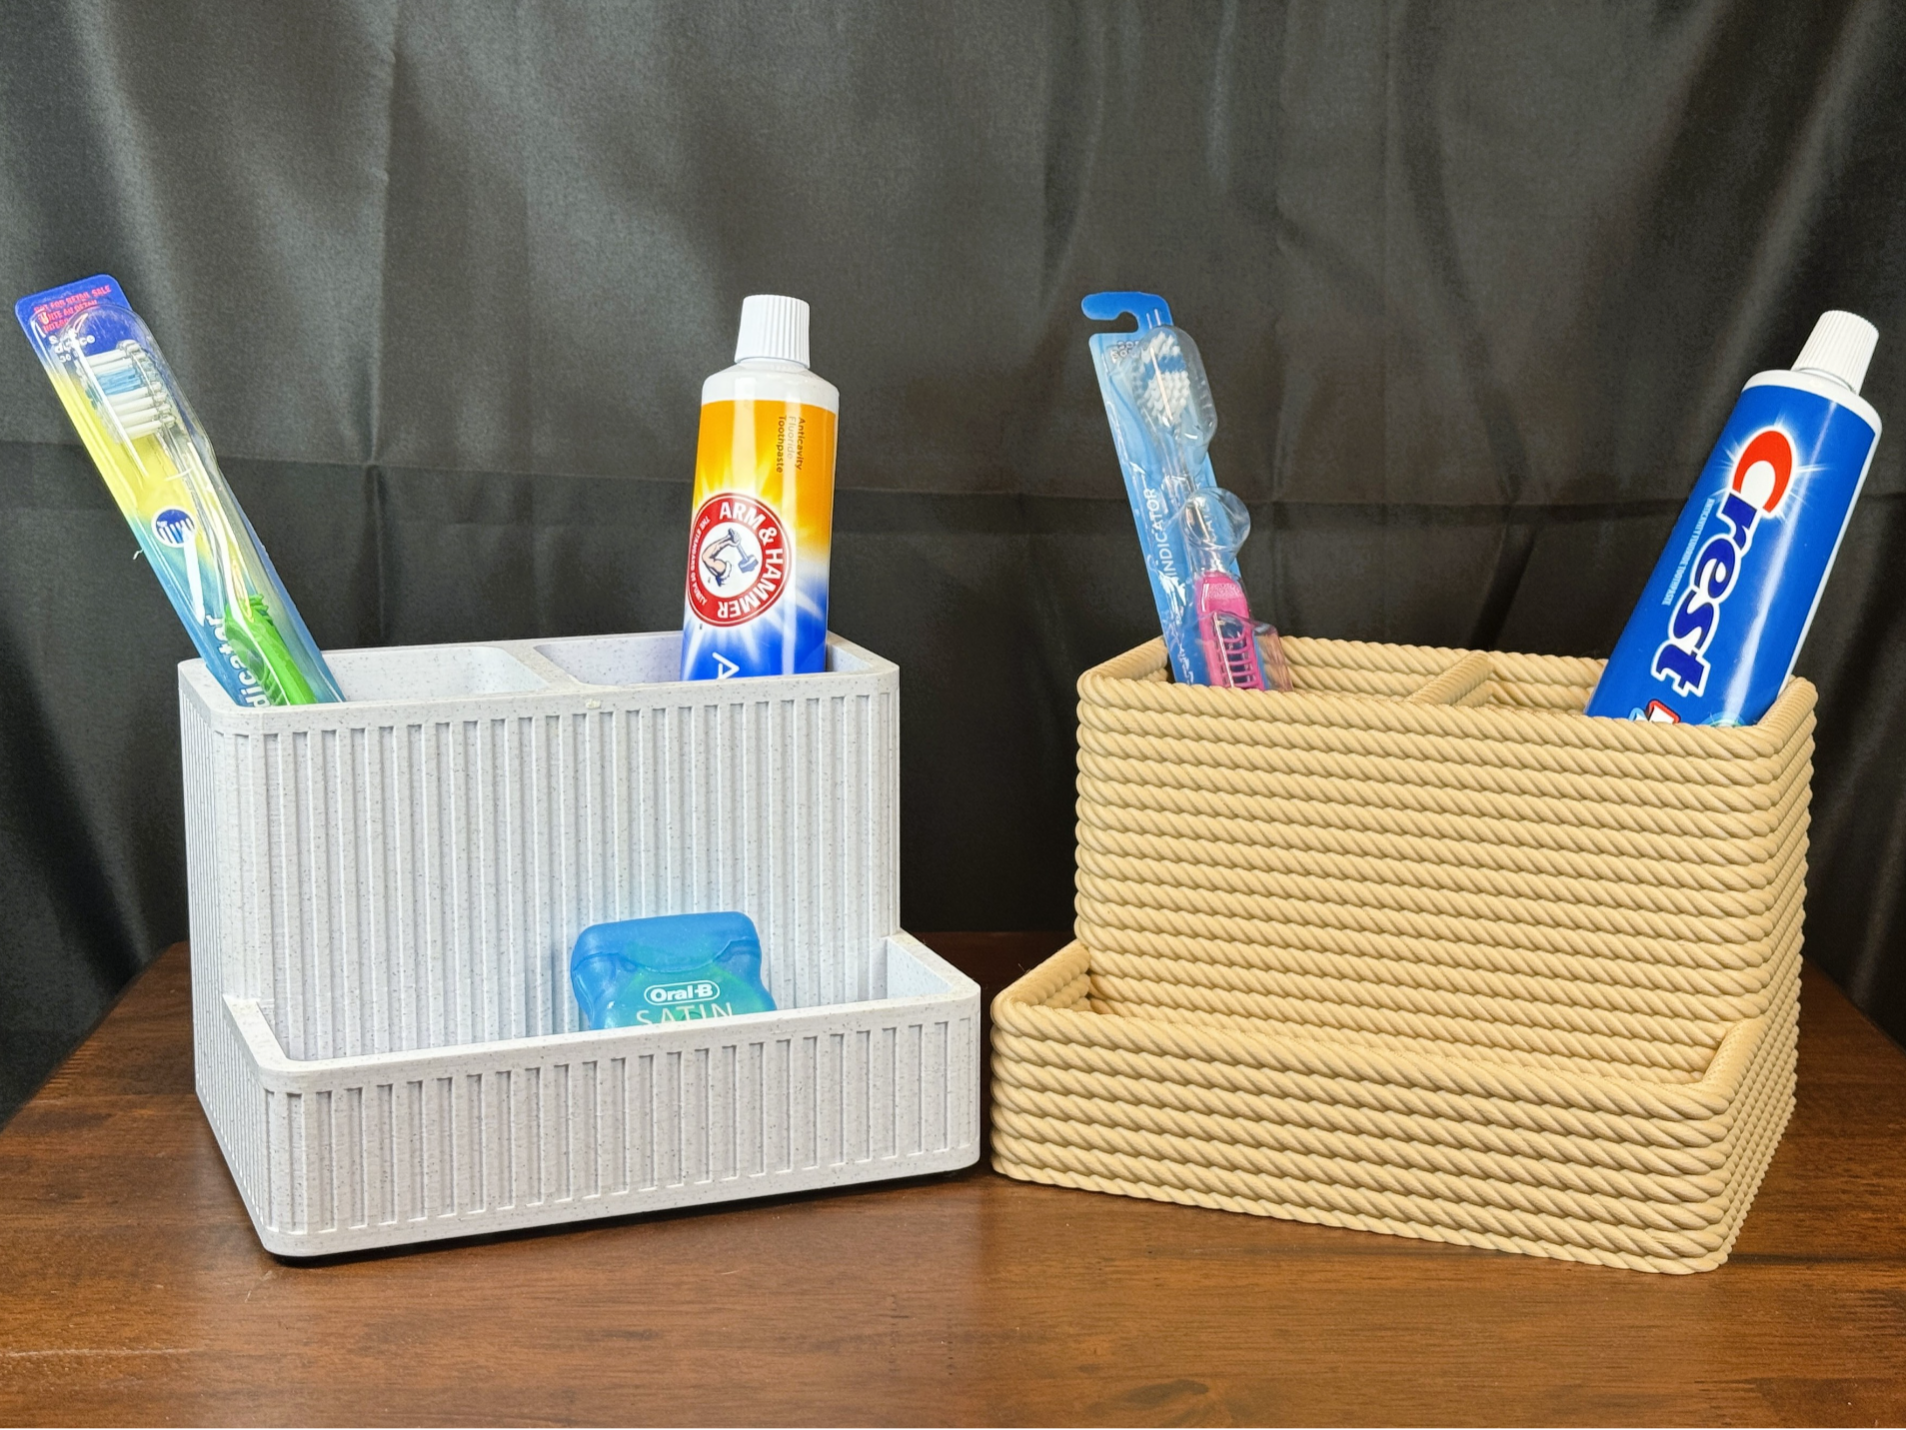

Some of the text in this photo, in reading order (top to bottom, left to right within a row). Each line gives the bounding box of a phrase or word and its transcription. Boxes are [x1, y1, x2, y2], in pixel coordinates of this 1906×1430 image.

[91, 285, 112, 297] SALE
[775, 415, 787, 474] Toothpaste
[787, 416, 797, 460] Fluoride
[795, 416, 806, 470] Anticavity
[717, 501, 784, 619] ARM & HAMMER
[1143, 487, 1179, 579] INDICATOR
[1651, 426, 1797, 697] Crest
[636, 1001, 734, 1026] SATIN
[650, 983, 714, 1003] Oral-B
